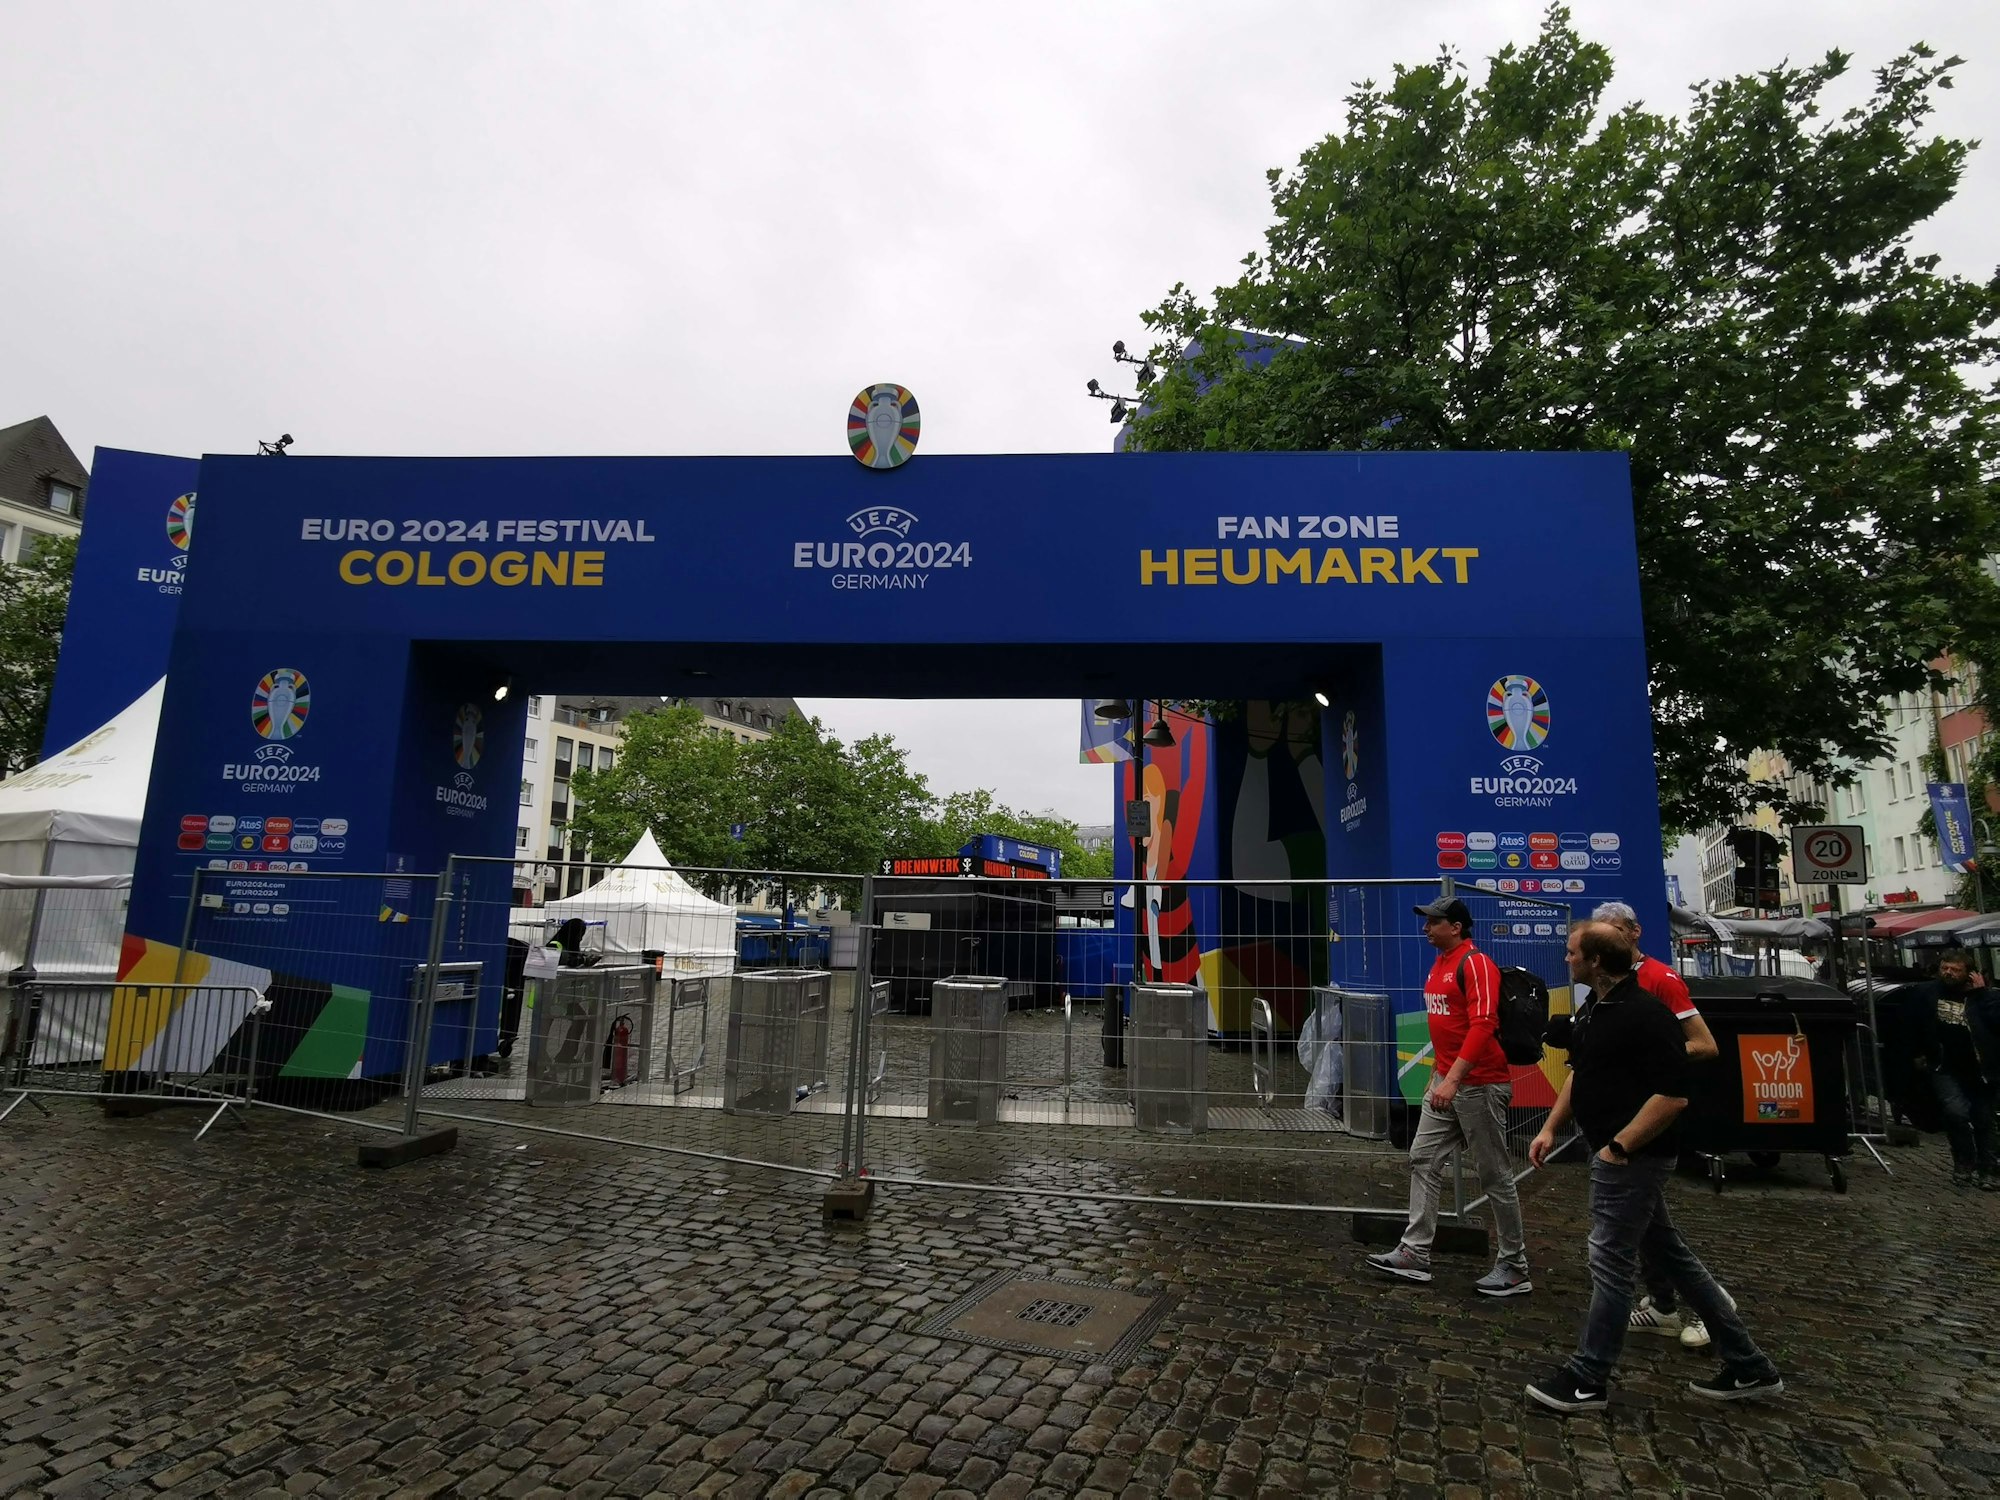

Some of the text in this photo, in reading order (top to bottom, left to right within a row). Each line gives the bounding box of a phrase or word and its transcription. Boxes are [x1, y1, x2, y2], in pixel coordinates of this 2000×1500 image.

[301, 518, 656, 543] EURO 2024 FESTIVAL
[850, 511, 912, 534] UEFA
[1217, 515, 1399, 540] FAN ZONE
[793, 541, 973, 569] EURO2024
[339, 550, 606, 587] COLOGNE
[1140, 547, 1480, 585] HEUMARKT
[831, 574, 930, 590] GERMANY
[255, 747, 290, 762] UEFA
[222, 763, 321, 783] EURO2024
[1502, 758, 1540, 773] UEFA
[241, 783, 296, 793] GERMANY
[1470, 777, 1578, 795] EURO2024
[436, 786, 488, 811] EURO2024
[1494, 797, 1554, 807] GERMANY
[319, 841, 345, 849] vivo
[1815, 840, 1842, 857] 20
[893, 858, 960, 875] BRENNWERK
[1592, 856, 1621, 864] vivo
[1812, 870, 1849, 880] ZONE
[225, 880, 286, 889] EURO2024.com
[230, 889, 279, 897] #EURO2024
[1502, 881, 1513, 889] DB
[1505, 909, 1558, 917] #EURO2024
[1423, 992, 1450, 1015] UISSE
[1752, 1082, 1804, 1099] TOOOOR
